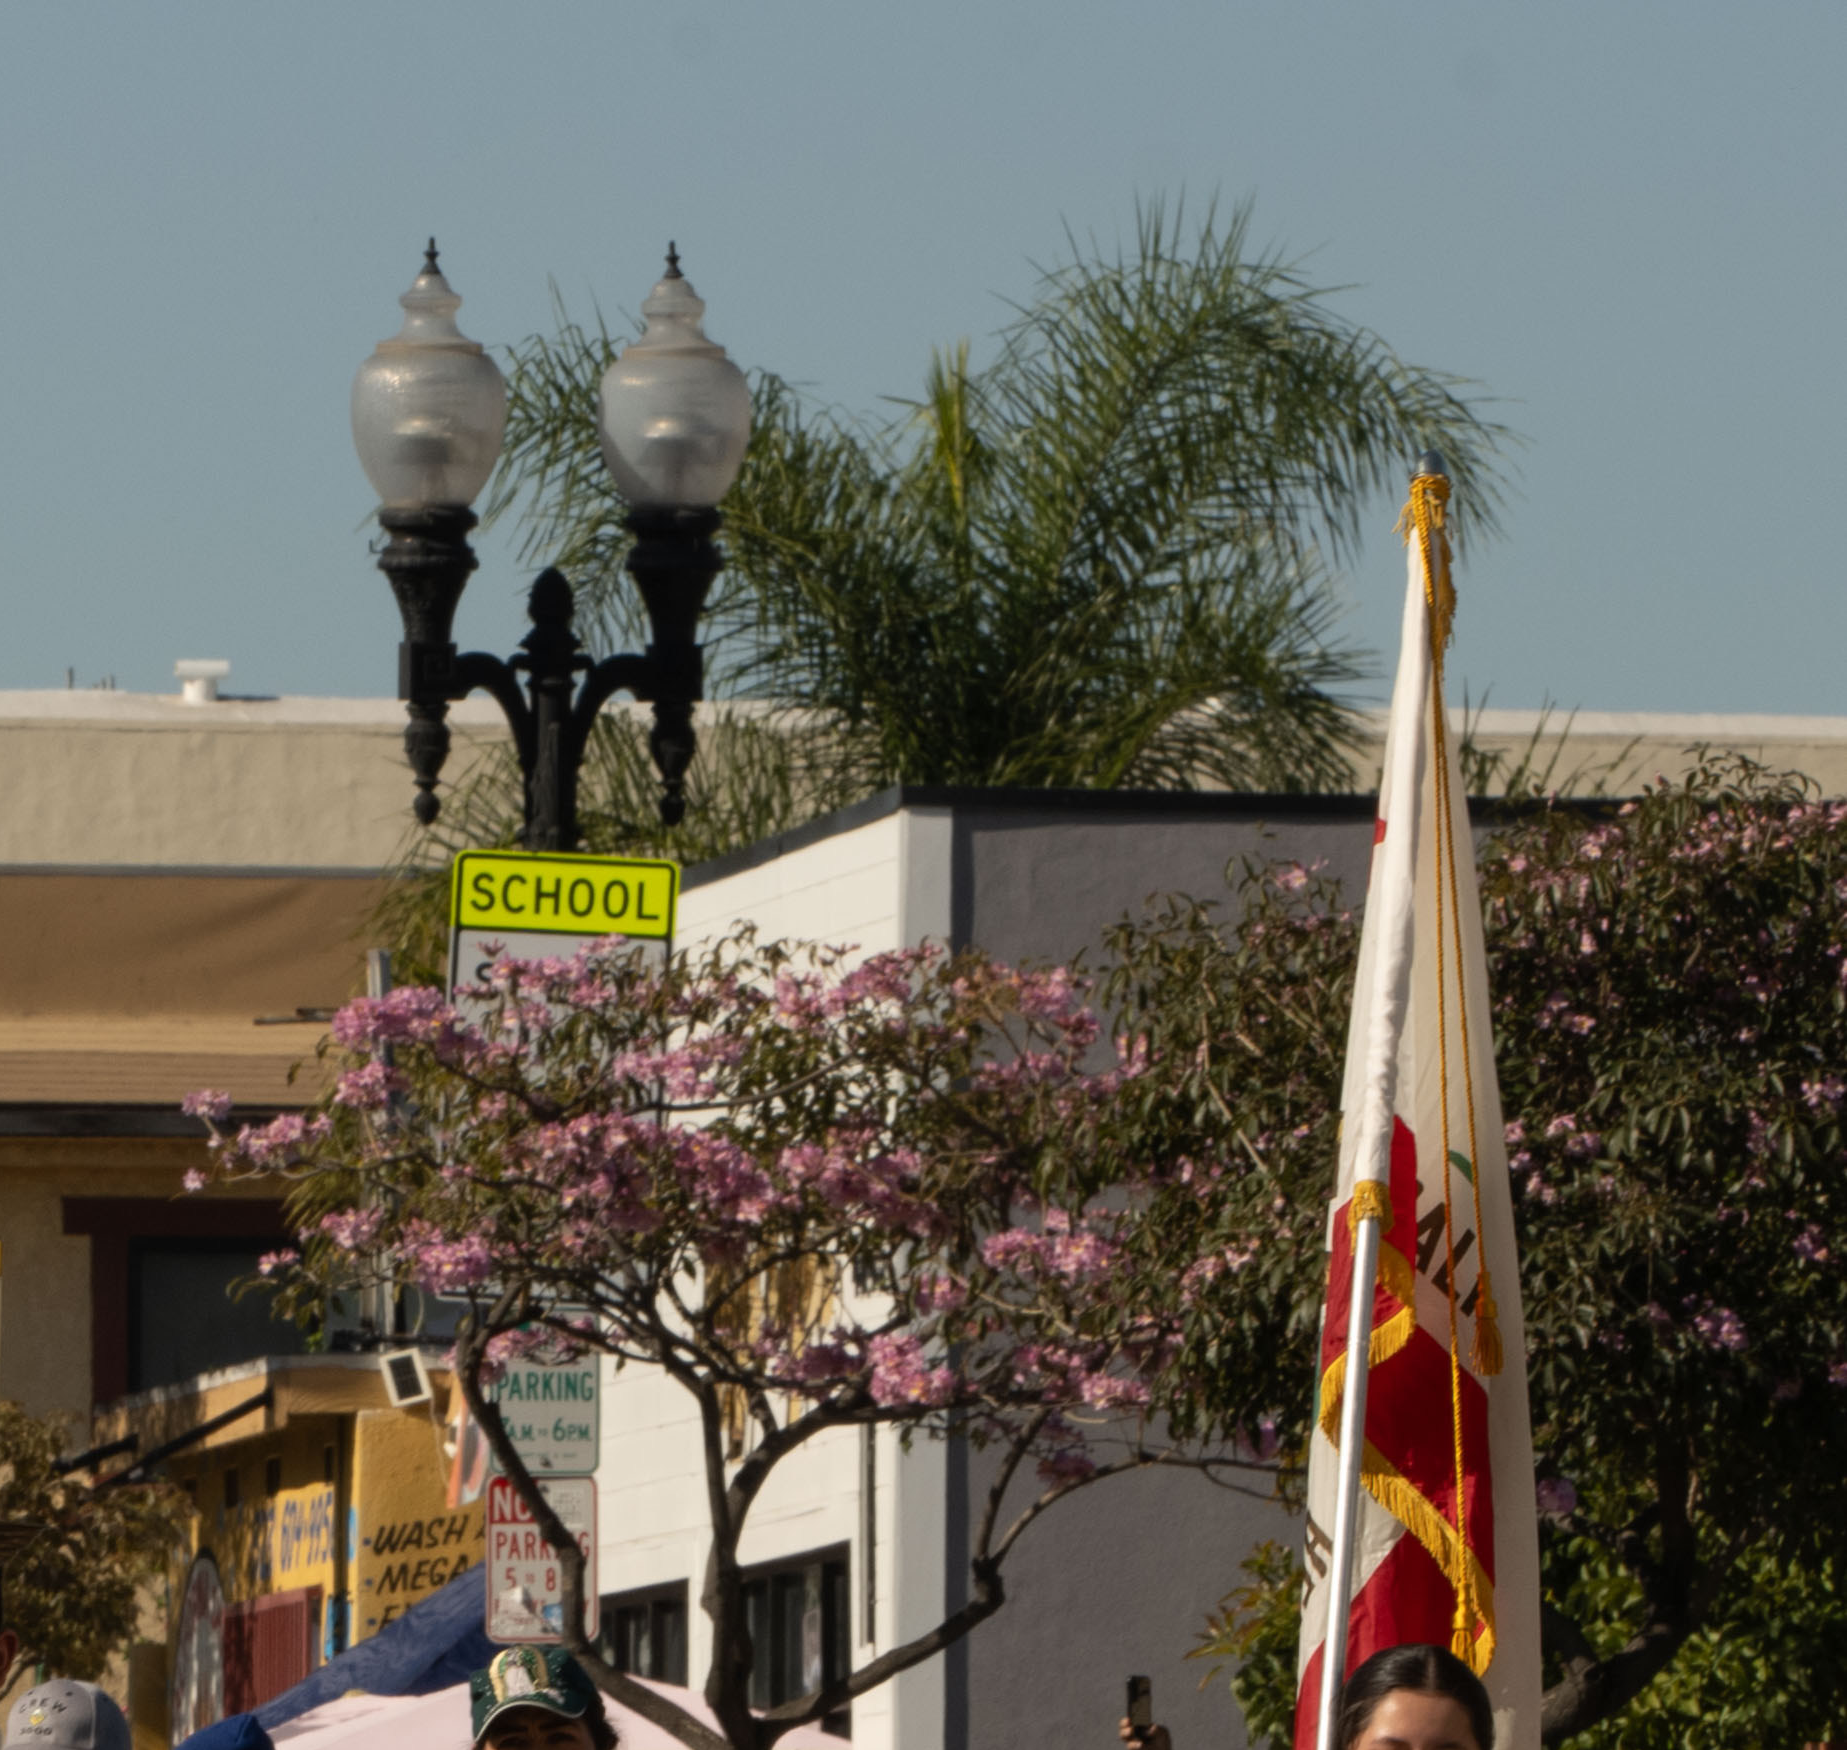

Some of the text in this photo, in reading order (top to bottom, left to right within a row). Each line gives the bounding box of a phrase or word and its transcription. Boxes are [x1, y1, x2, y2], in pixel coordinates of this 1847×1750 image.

[470, 872, 660, 920] SCHOOL
[496, 1371, 594, 1401] PARKING
[373, 1513, 469, 1556] WASH
[496, 1531, 591, 1561] PARKG
[376, 1554, 469, 1597] MEGA
[505, 1567, 517, 1588] 5
[545, 1567, 557, 1592] 8
[19, 1697, 67, 1713] CREW
